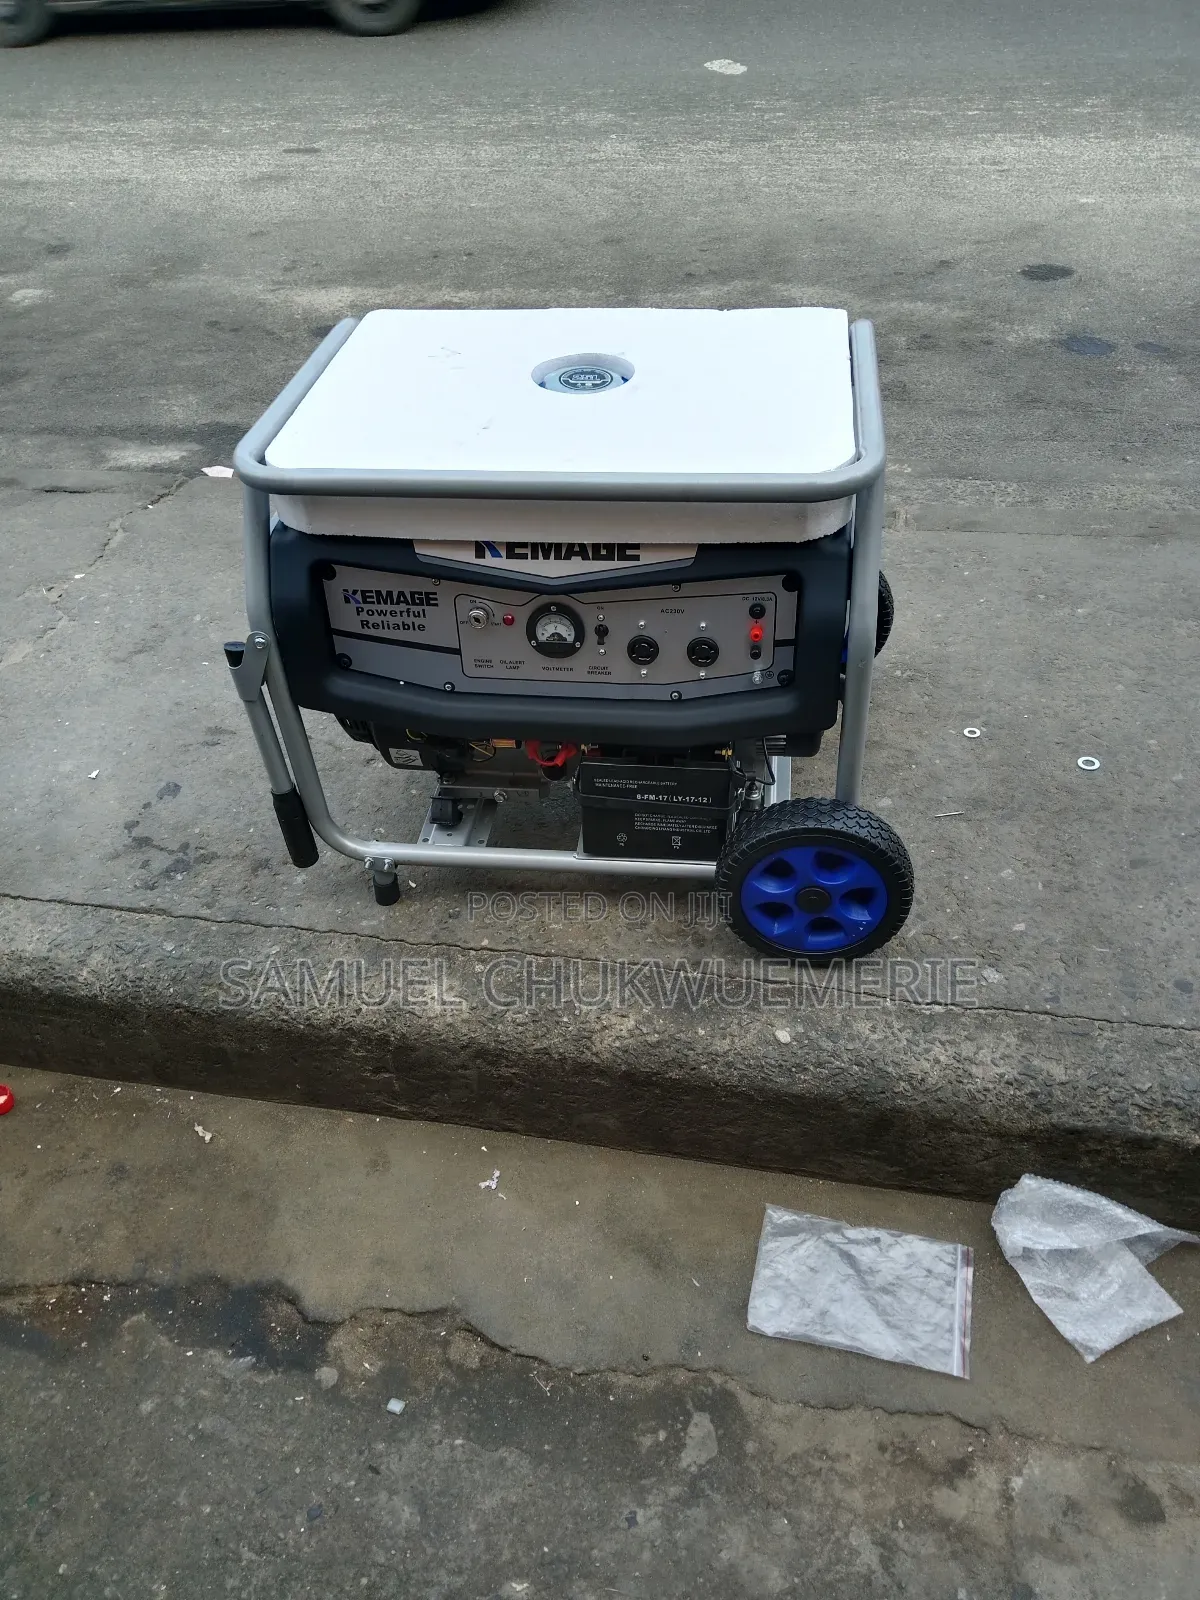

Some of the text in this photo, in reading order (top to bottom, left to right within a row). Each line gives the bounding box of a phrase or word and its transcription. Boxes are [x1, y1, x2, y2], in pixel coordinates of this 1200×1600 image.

[475, 541, 641, 561] KEMAGE
[342, 588, 439, 607] KEMAGE
[355, 606, 427, 619] Powerful
[360, 619, 426, 632] Reliable
